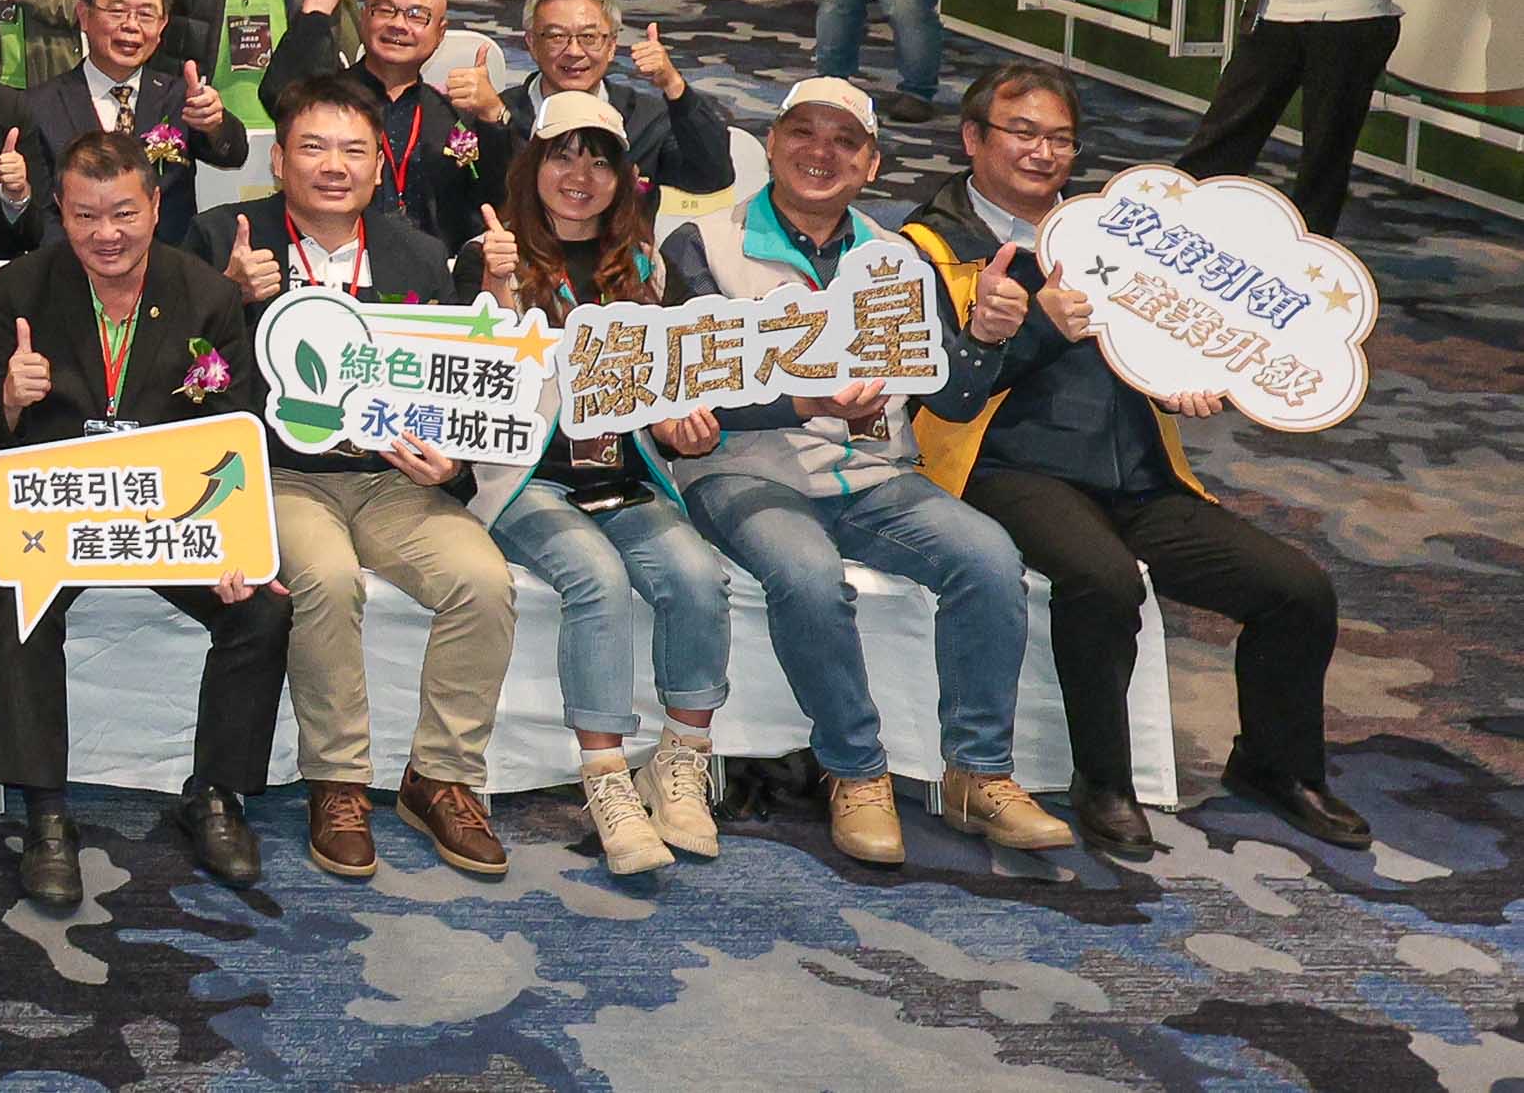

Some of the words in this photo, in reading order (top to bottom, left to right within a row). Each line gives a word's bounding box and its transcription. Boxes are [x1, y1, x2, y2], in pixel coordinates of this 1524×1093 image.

[1098, 196, 1312, 330] 政策引領
[567, 278, 938, 424] 綠店之星
[1108, 272, 1324, 407] 產業升級
[339, 341, 518, 401] 綠色服務
[360, 397, 533, 454] 永續城市
[12, 470, 160, 508] 政策引領
[71, 523, 219, 561] 產業升級
